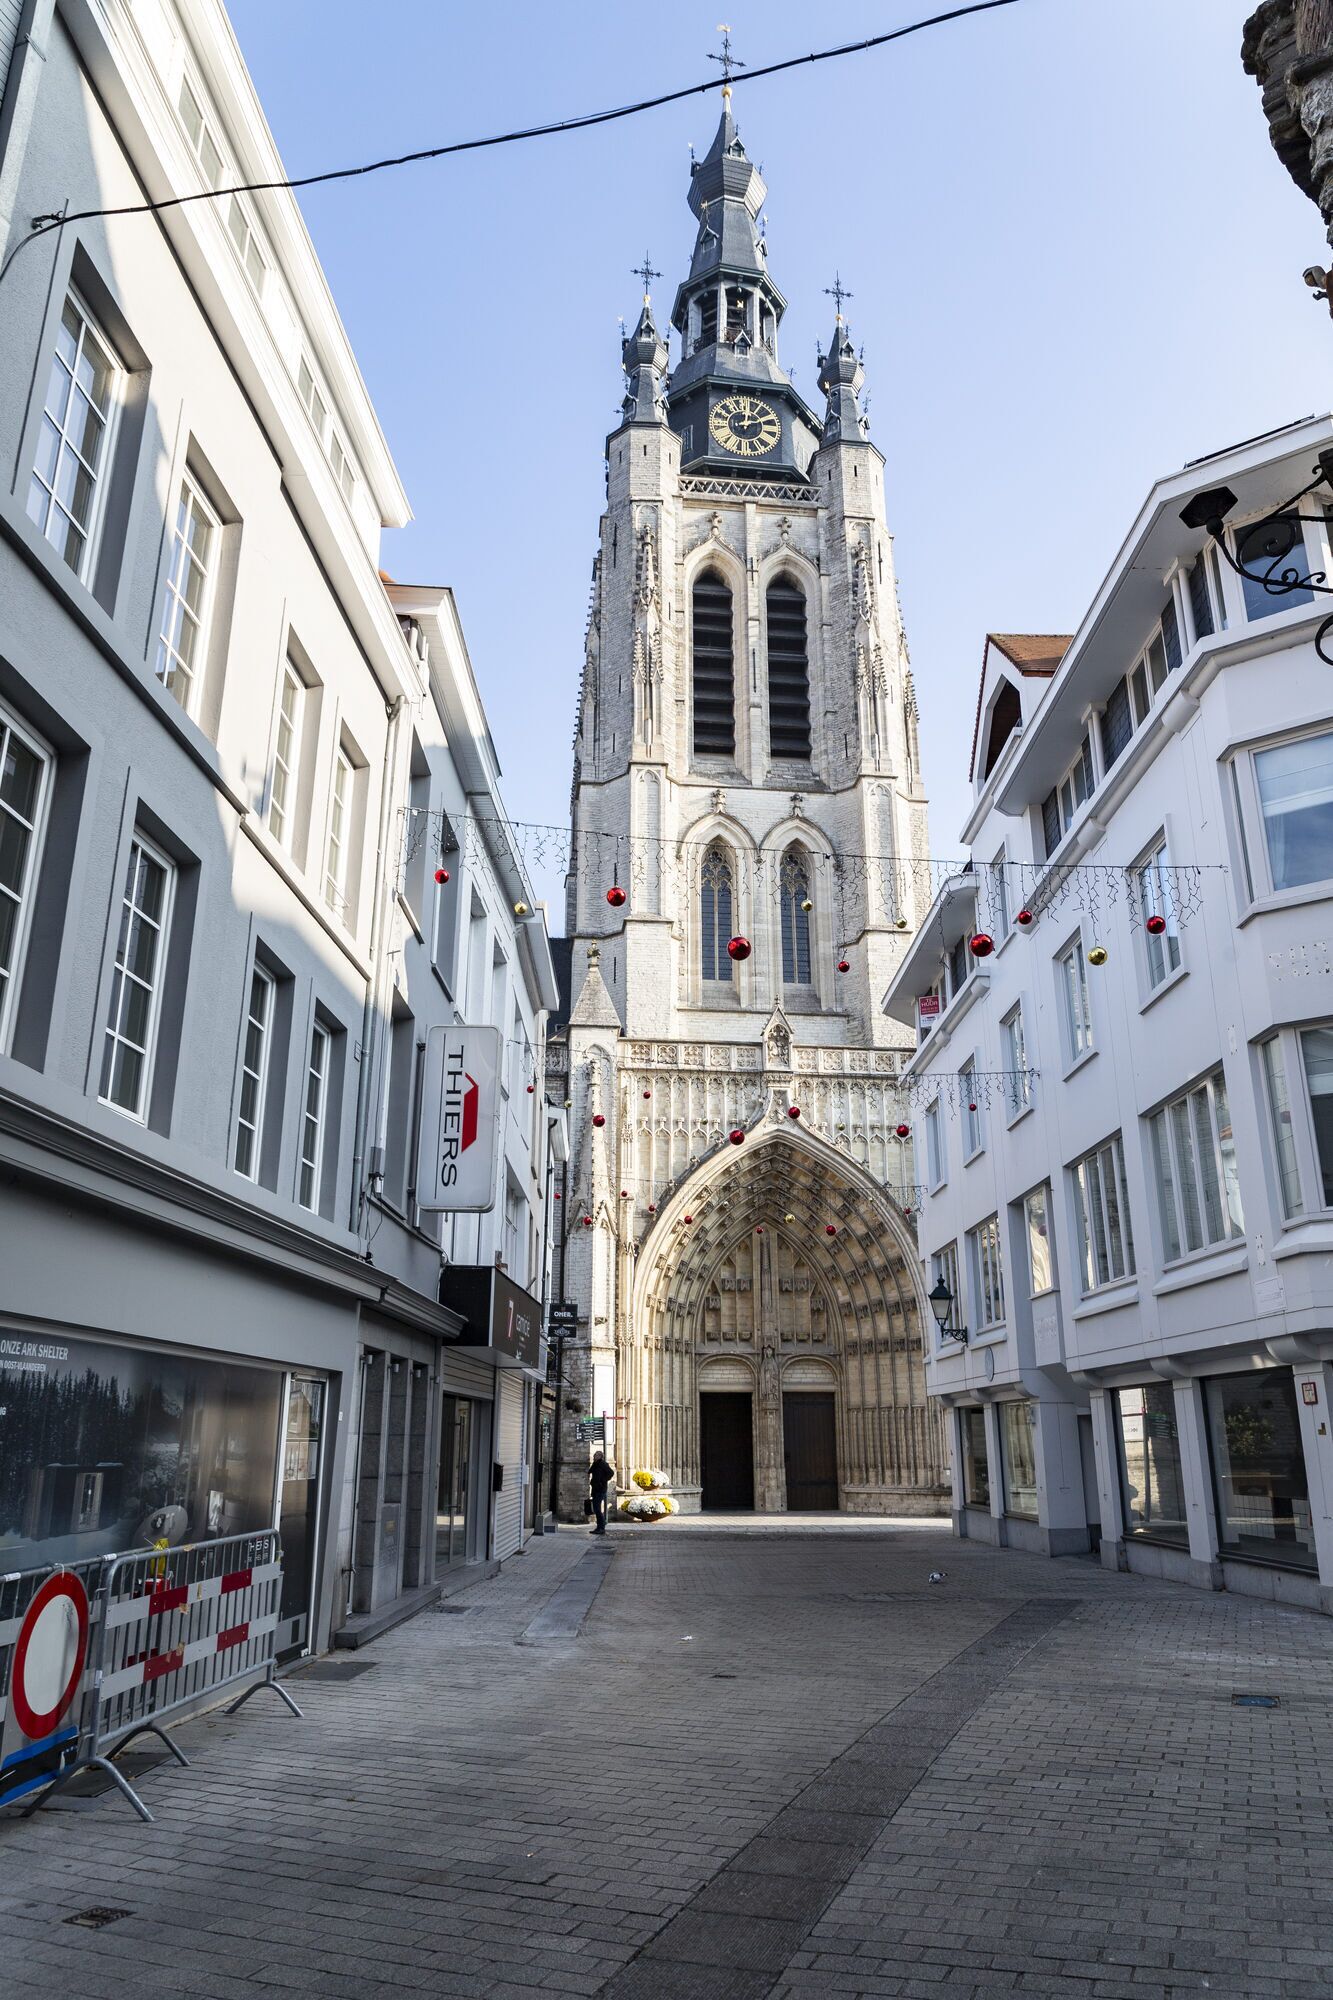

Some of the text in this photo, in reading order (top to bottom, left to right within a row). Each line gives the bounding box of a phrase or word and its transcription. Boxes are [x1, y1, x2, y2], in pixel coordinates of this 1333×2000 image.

[441, 1045, 464, 1187] THIERS
[1, 1340, 69, 1360] ONZE ARK SHELTER
